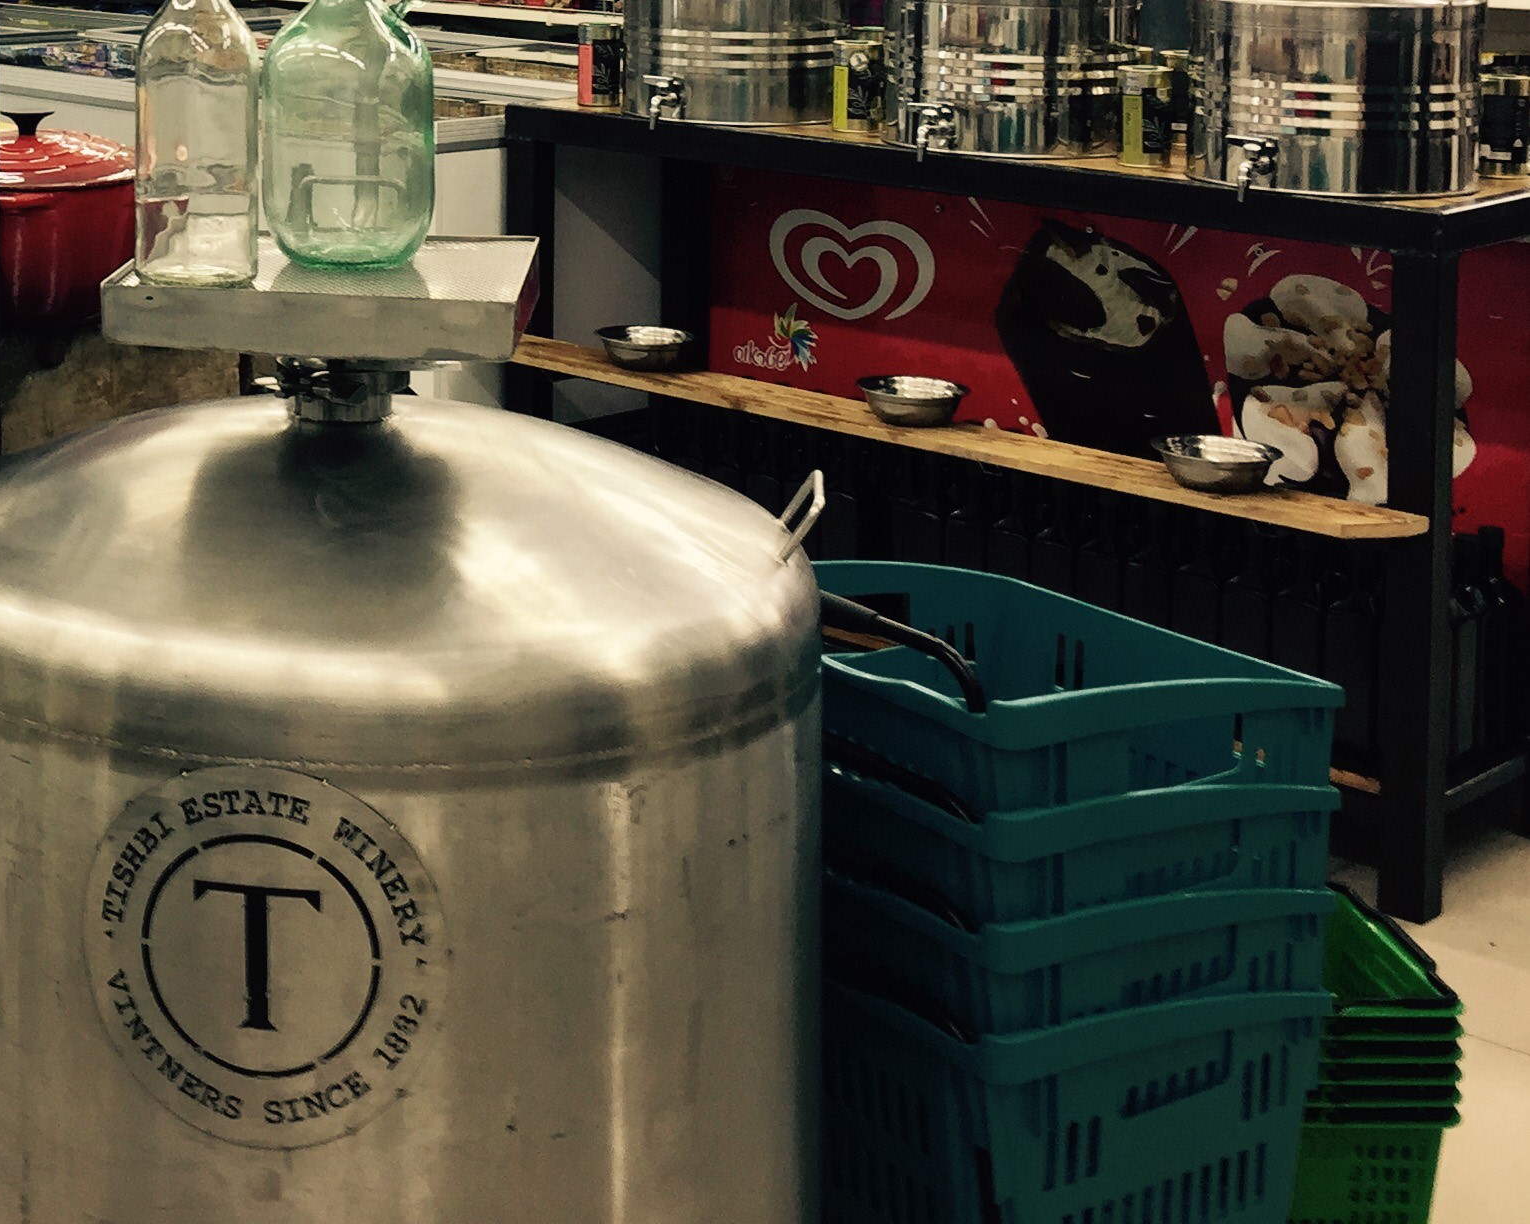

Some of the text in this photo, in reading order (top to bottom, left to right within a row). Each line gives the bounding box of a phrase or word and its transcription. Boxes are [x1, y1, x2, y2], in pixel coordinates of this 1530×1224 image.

[101, 790, 429, 947] TISHBI ESTATE WINERY
[192, 879, 322, 1032] T
[106, 969, 243, 1121] VINTNERS
[263, 1072, 373, 1125] SINCE
